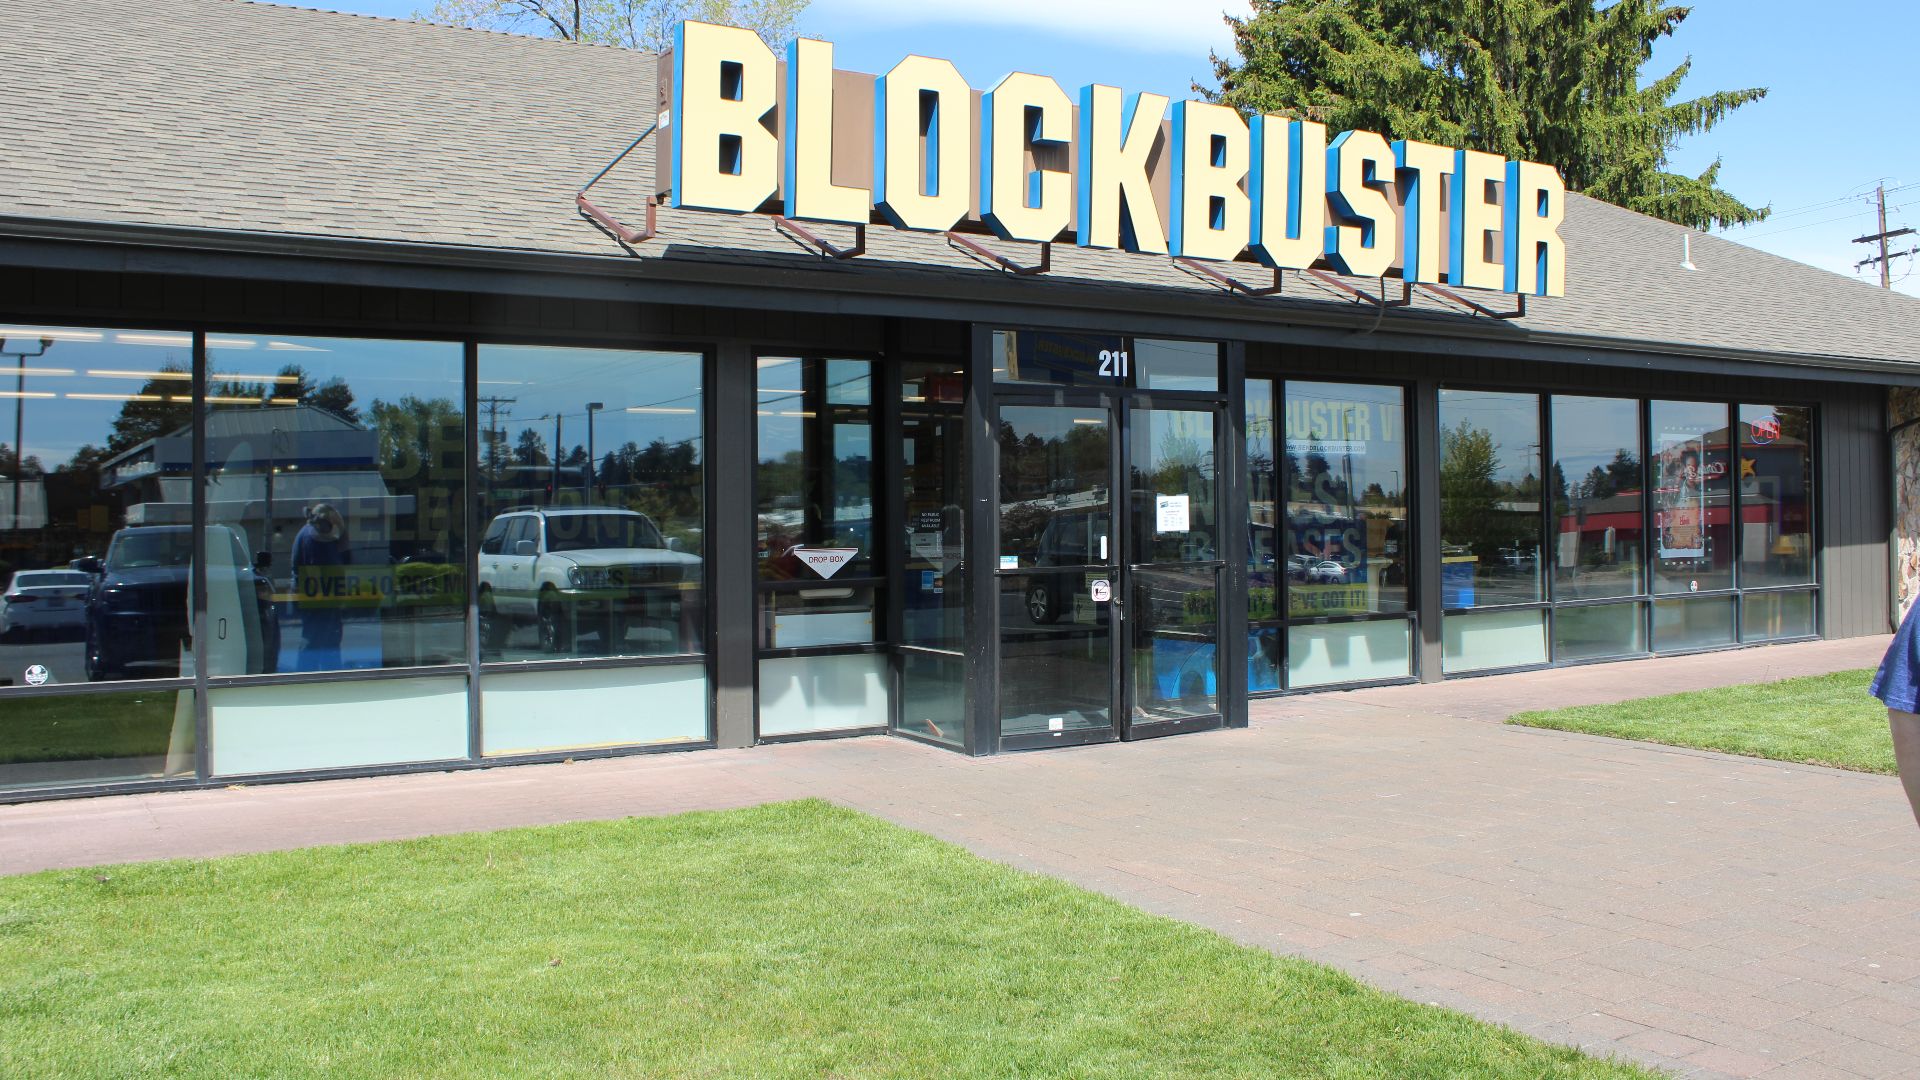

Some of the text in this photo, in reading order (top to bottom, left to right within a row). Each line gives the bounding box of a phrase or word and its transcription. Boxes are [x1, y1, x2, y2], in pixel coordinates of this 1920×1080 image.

[673, 20, 1566, 298] BLOCKBUSTER
[1098, 350, 1128, 377] 211
[1751, 420, 1781, 440] OPEN
[808, 555, 845, 564] DROP BOX
[304, 575, 360, 597] OVER
[1321, 590, 1345, 610] GOT
[1349, 588, 1366, 607] IT!
